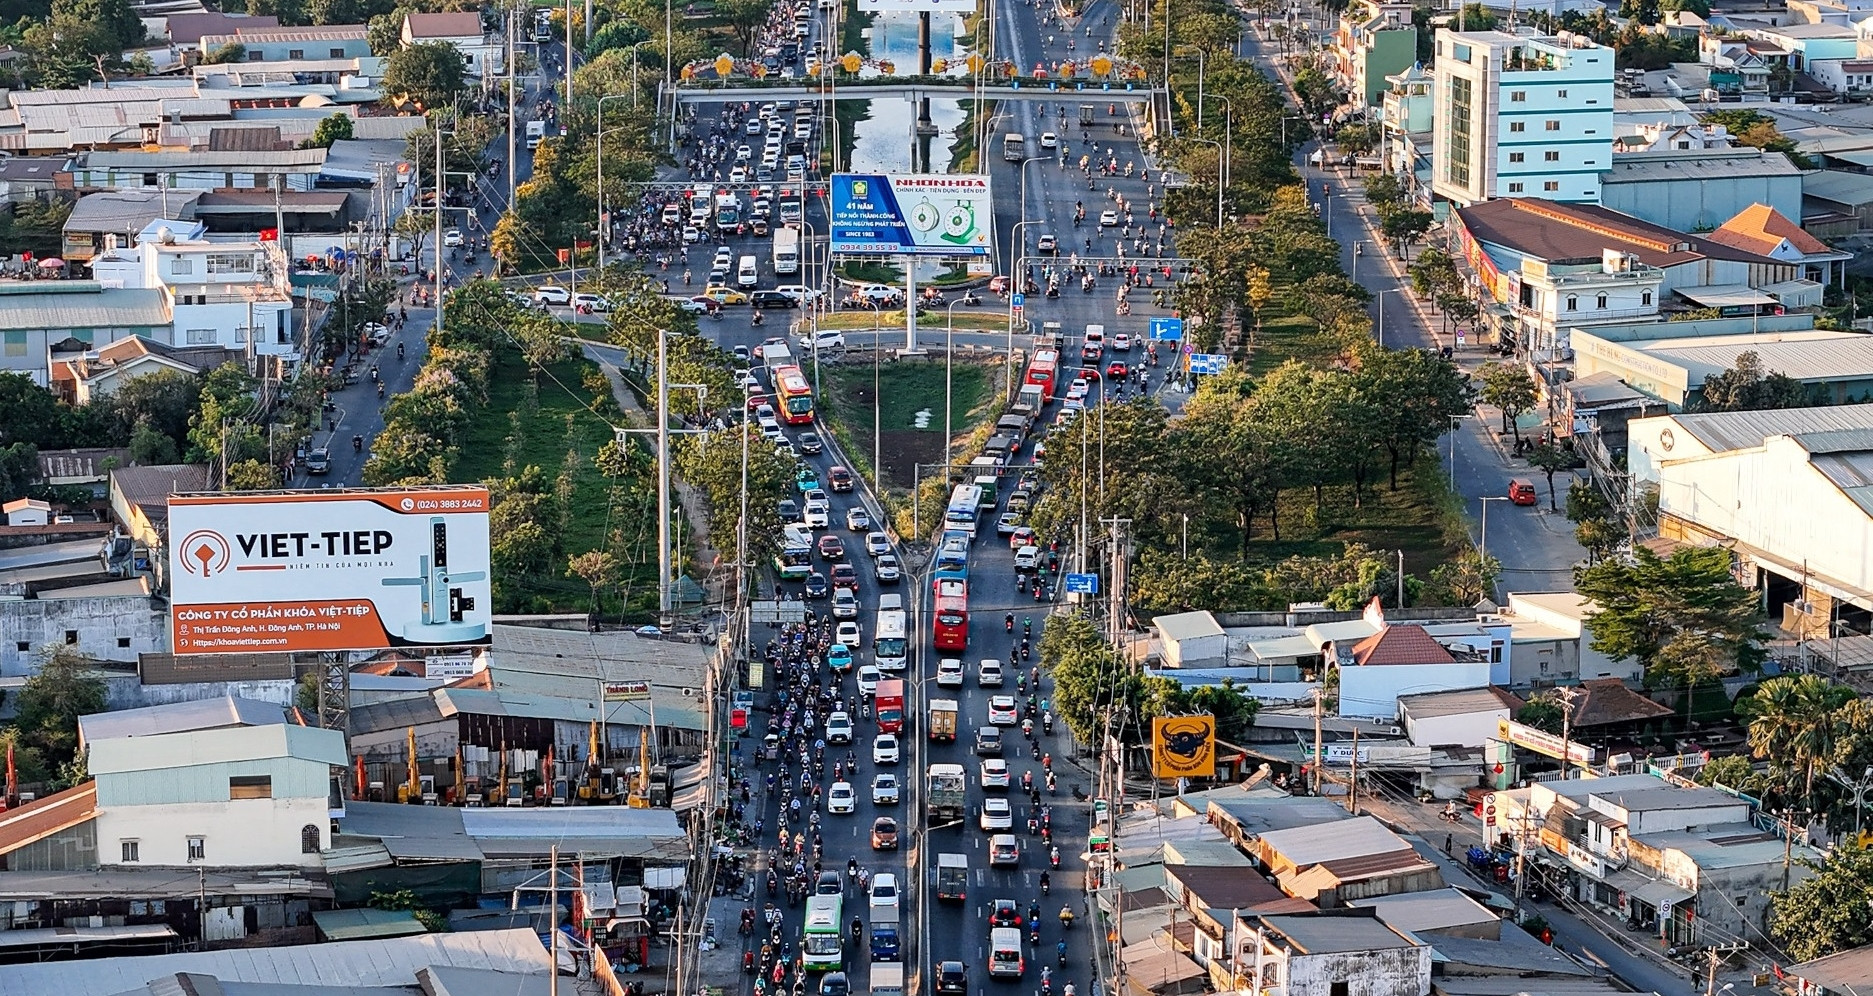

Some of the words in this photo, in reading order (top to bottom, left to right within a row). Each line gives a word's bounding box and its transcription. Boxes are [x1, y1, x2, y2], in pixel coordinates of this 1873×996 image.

[417, 500, 438, 510] (024)
[440, 500, 460, 509] 3883
[461, 499, 482, 508] 2442
[236, 530, 393, 558] VIET-TIEP
[178, 608, 212, 620] CÔNG
[214, 610, 229, 619] TY
[231, 606, 248, 619] CỔ
[250, 605, 282, 618] PHẦN
[284, 606, 316, 618] KHÓA
[318, 604, 370, 618] VIỆT-TIỆP
[205, 625, 221, 633] Trấn
[222, 625, 240, 634] Đông
[242, 625, 258, 633] Anh,
[268, 624, 287, 632] Đông
[288, 624, 304, 632] Anh,
[327, 622, 340, 631] Nội
[193, 637, 287, 647] Https://khoaviettiep.com.vn
